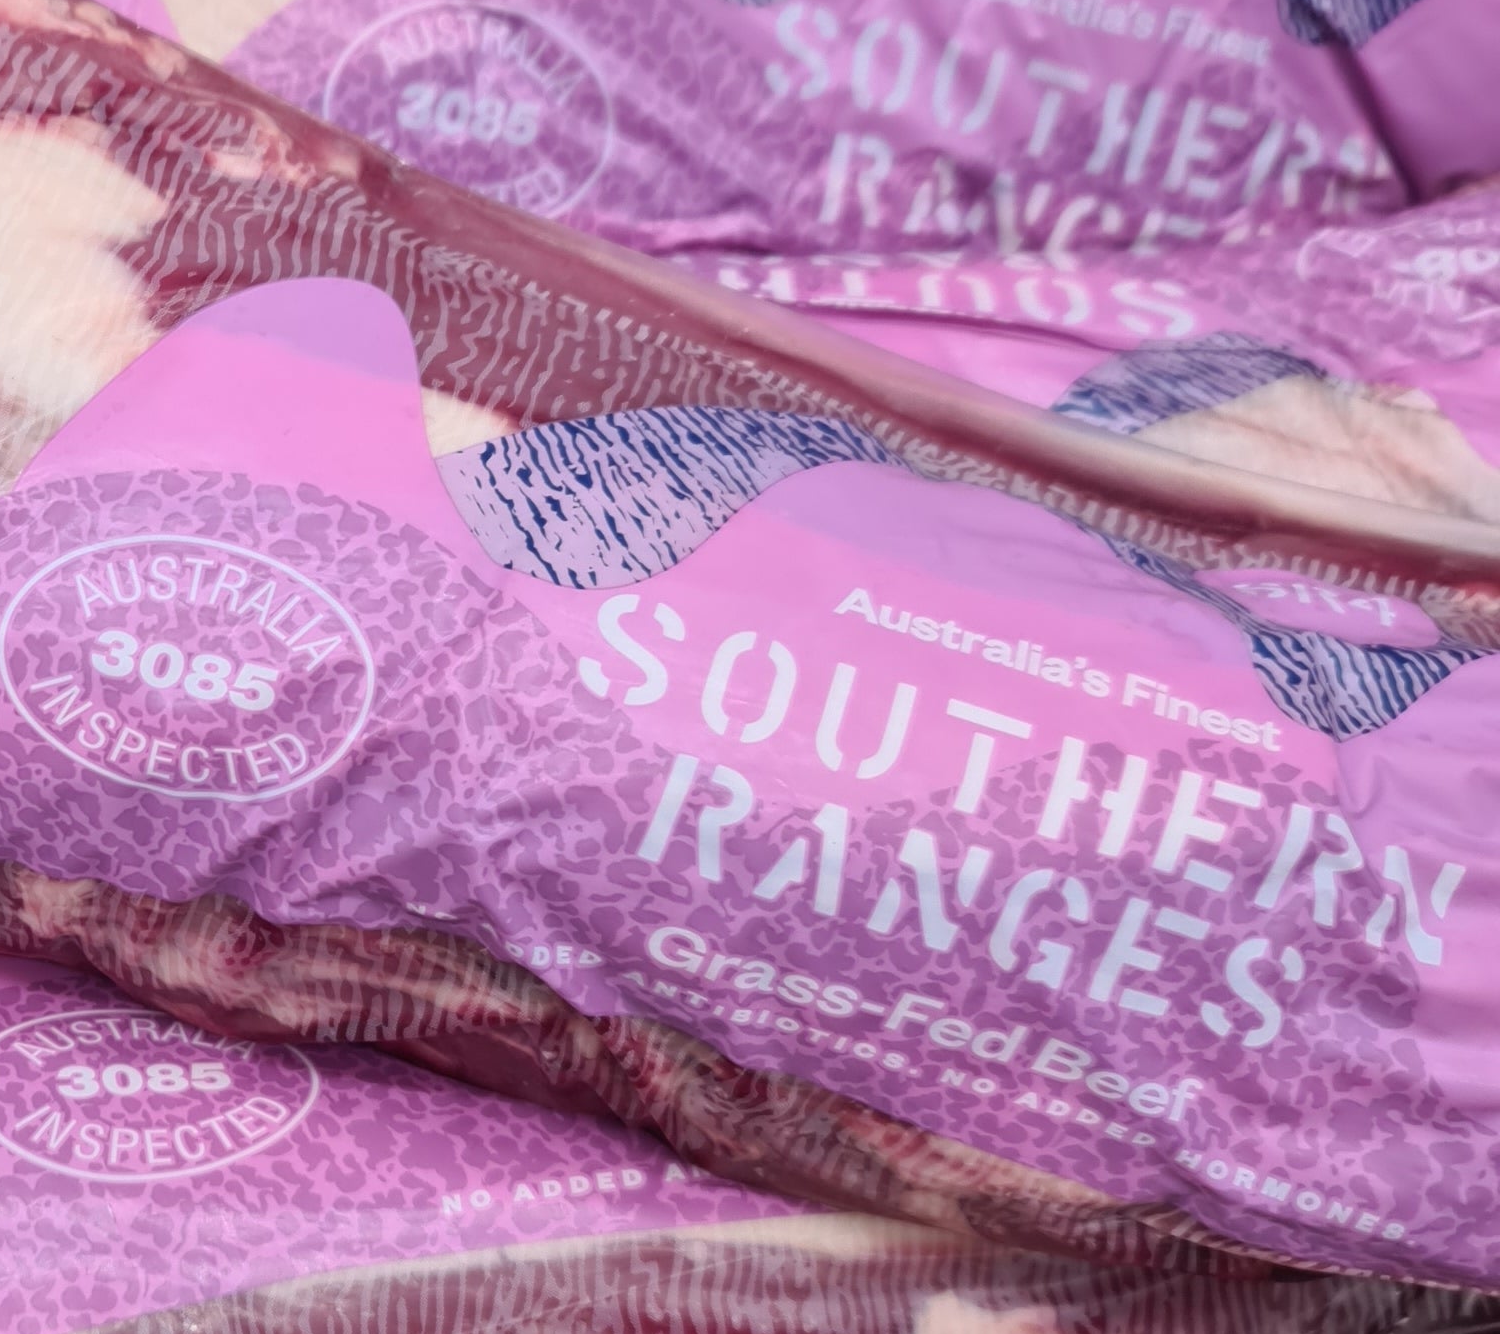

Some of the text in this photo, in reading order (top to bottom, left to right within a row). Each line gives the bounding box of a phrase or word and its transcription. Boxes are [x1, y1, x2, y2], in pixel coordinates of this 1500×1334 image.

[74, 556, 343, 674] AUSTRALIA
[91, 630, 279, 712] 3085
[834, 587, 1283, 752] Australia's Finest
[30, 673, 309, 788] INSPECTED
[578, 593, 1467, 965] SOUTHERN
[637, 753, 1304, 1048] RANGES
[11, 1017, 256, 1066] AUSTRALIA
[56, 1062, 232, 1100] 3085
[622, 970, 920, 1077] ANTIBIOTICS.
[940, 1067, 997, 1095] NO
[1013, 1091, 1156, 1147] ADDED
[647, 925, 1204, 1122] Grass-Fed Beef
[15, 1096, 289, 1166] INSPECTED
[441, 1188, 492, 1214] NO
[513, 1168, 644, 1202] ADDED
